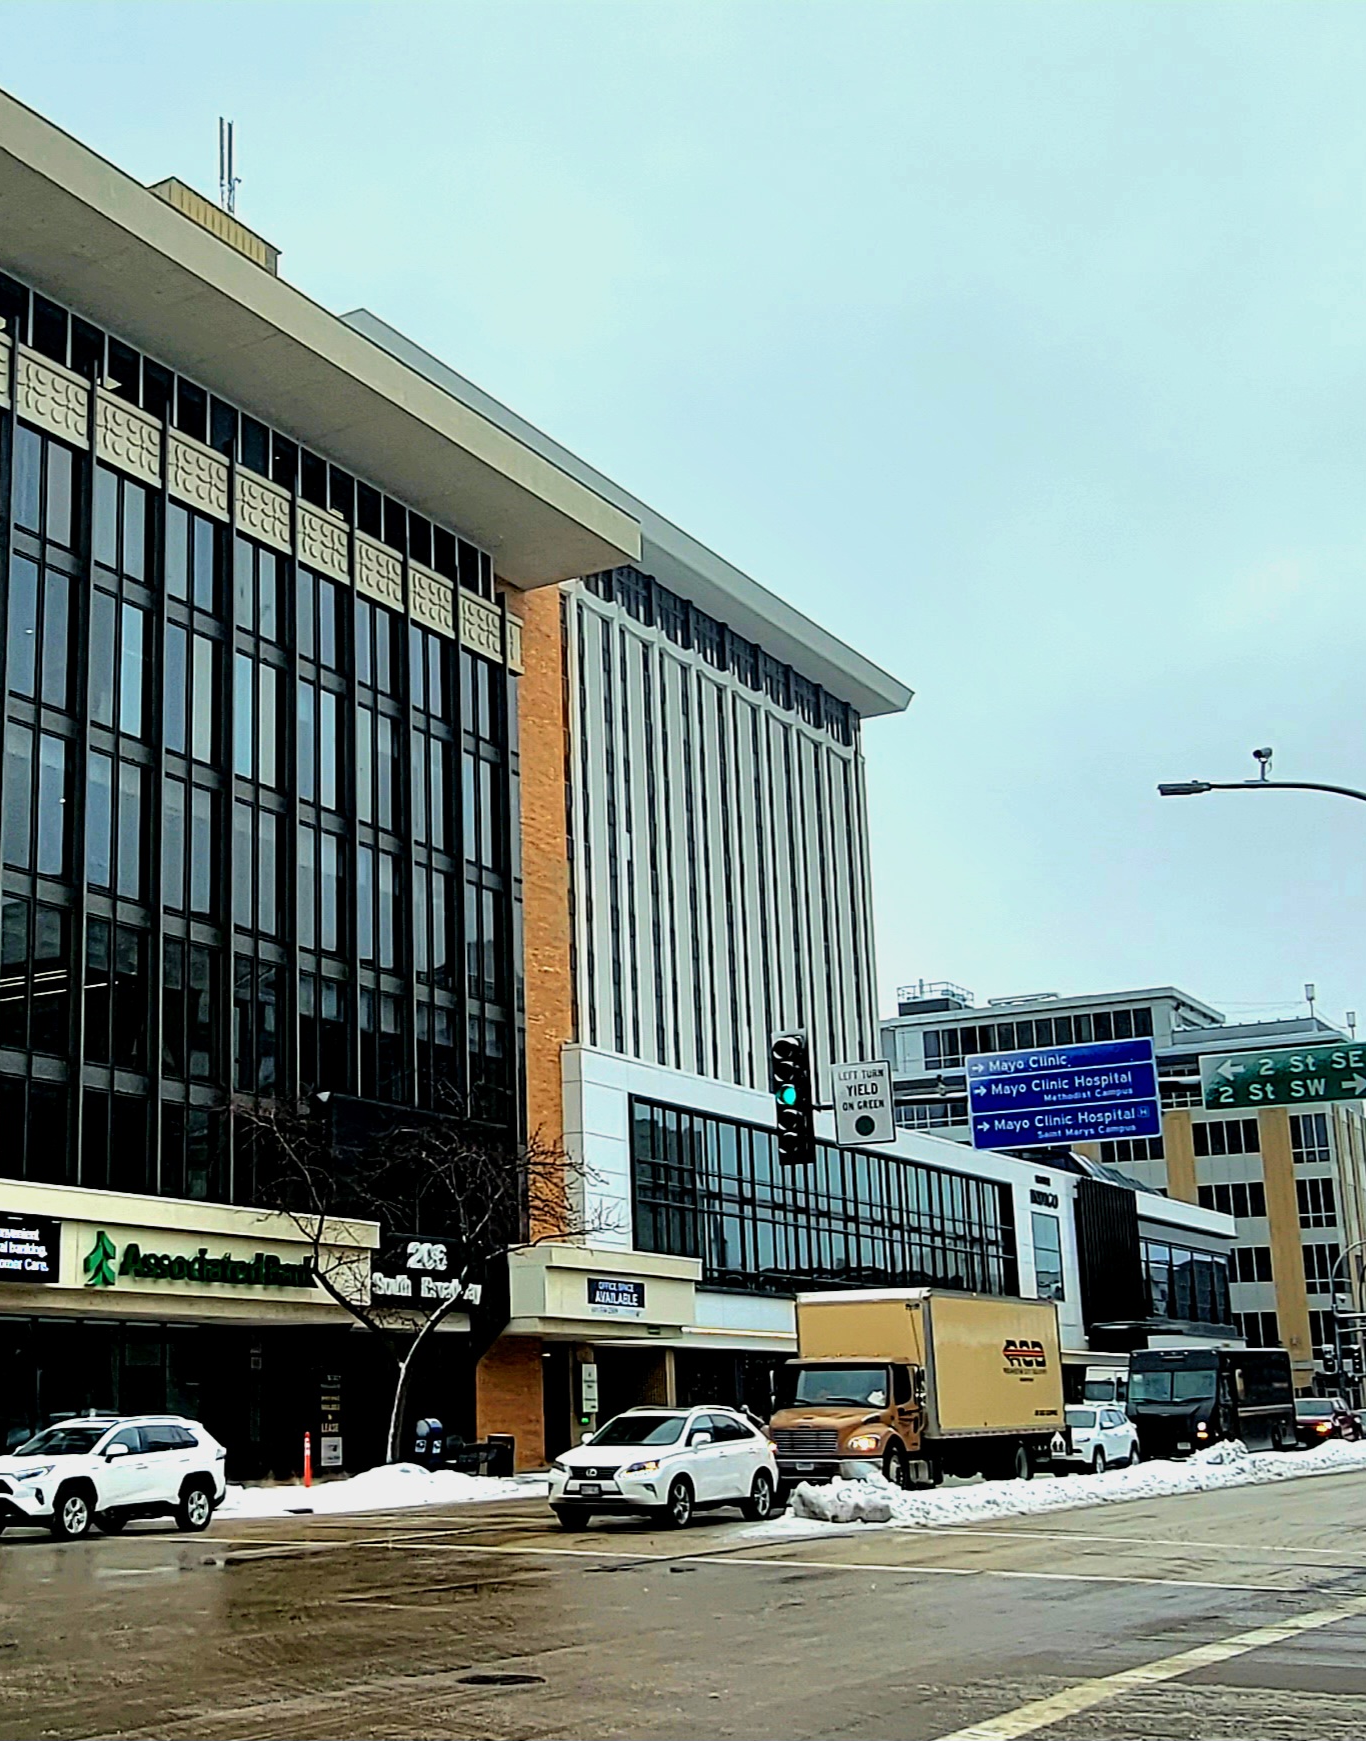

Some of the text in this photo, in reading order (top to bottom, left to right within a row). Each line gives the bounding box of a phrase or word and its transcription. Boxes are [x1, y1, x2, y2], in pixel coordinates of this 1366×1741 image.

[989, 1054, 1067, 1073] Mayo Clinic
[1258, 1050, 1365, 1076] 2 St SE
[838, 1068, 884, 1080] LEFT TURN
[846, 1083, 878, 1097] YIELD
[991, 1071, 1132, 1097] Mayo Clinic Hospital
[1219, 1078, 1325, 1103] 2 St SW
[1043, 1087, 1133, 1102] Methodist Campus
[842, 1099, 885, 1111] ON GREEN
[994, 1119, 1030, 1133] Mayo
[1034, 1114, 1073, 1127] Clinic
[1077, 1107, 1135, 1125] Hospital
[1037, 1124, 1137, 1139] Saint Marys Campus
[118, 1243, 264, 1287] Associated
[372, 1272, 412, 1297] South
[598, 1281, 617, 1291] OFFICE
[595, 1290, 639, 1306] AVAILABLE
